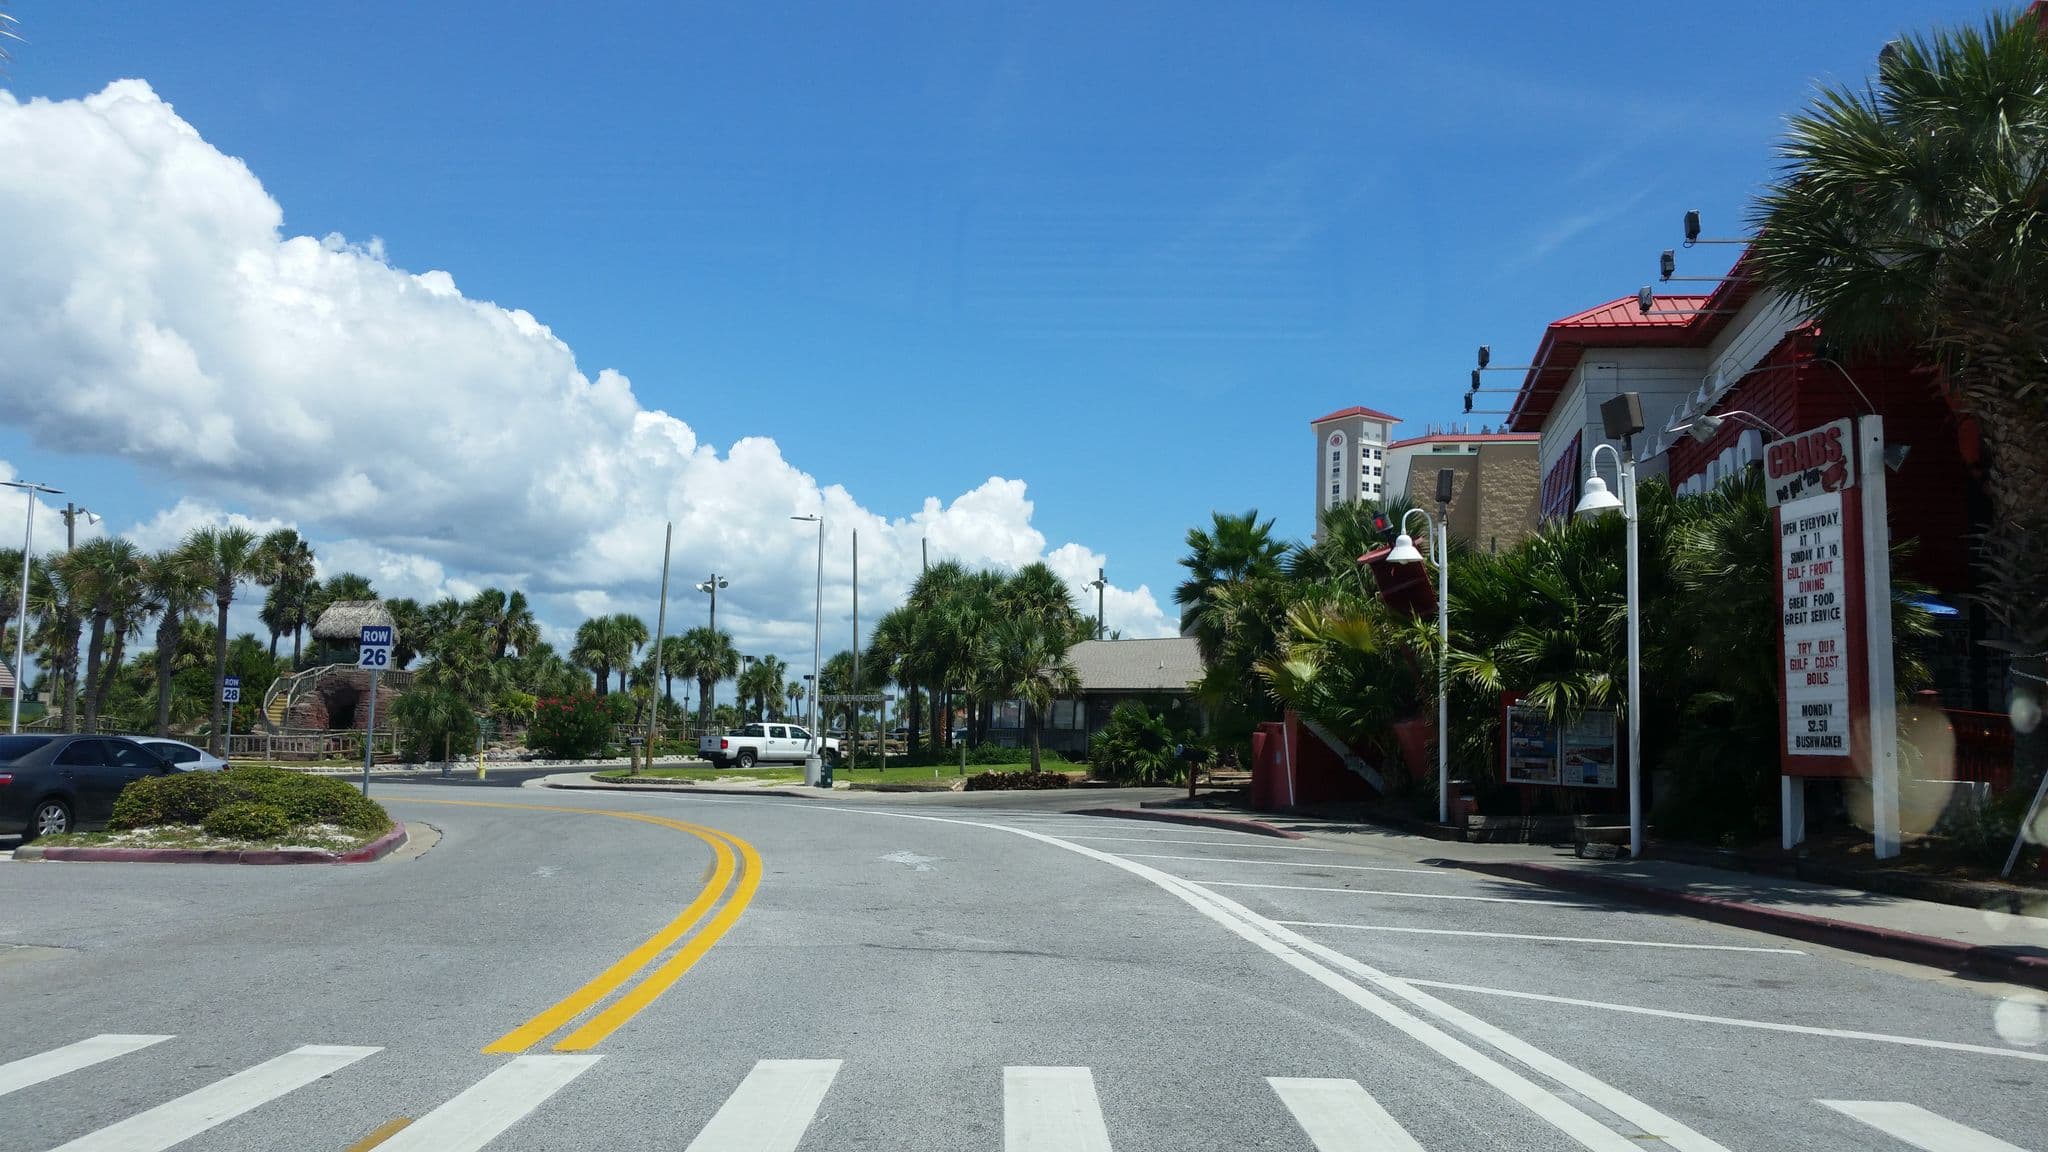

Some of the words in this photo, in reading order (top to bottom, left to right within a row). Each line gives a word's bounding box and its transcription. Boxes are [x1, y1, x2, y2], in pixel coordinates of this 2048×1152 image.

[1768, 427, 1843, 479] CRABS
[1783, 523, 1797, 536] OPEN
[1800, 511, 1839, 532] EVERYDAY
[1799, 535, 1808, 547] AT
[1790, 548, 1813, 564] SUNDAY
[1816, 547, 1825, 558] AT
[1829, 545, 1838, 557] 10
[1787, 566, 1806, 580] GULF
[1810, 561, 1833, 574] FRONT
[1799, 578, 1825, 593] DINING
[1789, 596, 1808, 609] GREAT
[1813, 592, 1834, 606] FOOD
[1784, 612, 1808, 626] GREAT
[1811, 607, 1841, 622] SERVICE
[363, 630, 388, 643] ROW
[1797, 642, 1812, 655] TRY
[1818, 640, 1835, 653] OUR
[362, 648, 387, 666] 26
[1790, 659, 1808, 671] GULF
[1815, 655, 1839, 668] COAST
[224, 678, 239, 687] ROW
[1806, 672, 1829, 685] BOILS
[224, 689, 238, 701] 28
[1801, 703, 1833, 717] MONDAY
[1807, 720, 1828, 732] $2.50
[1795, 735, 1842, 749] BUSHWACKER
